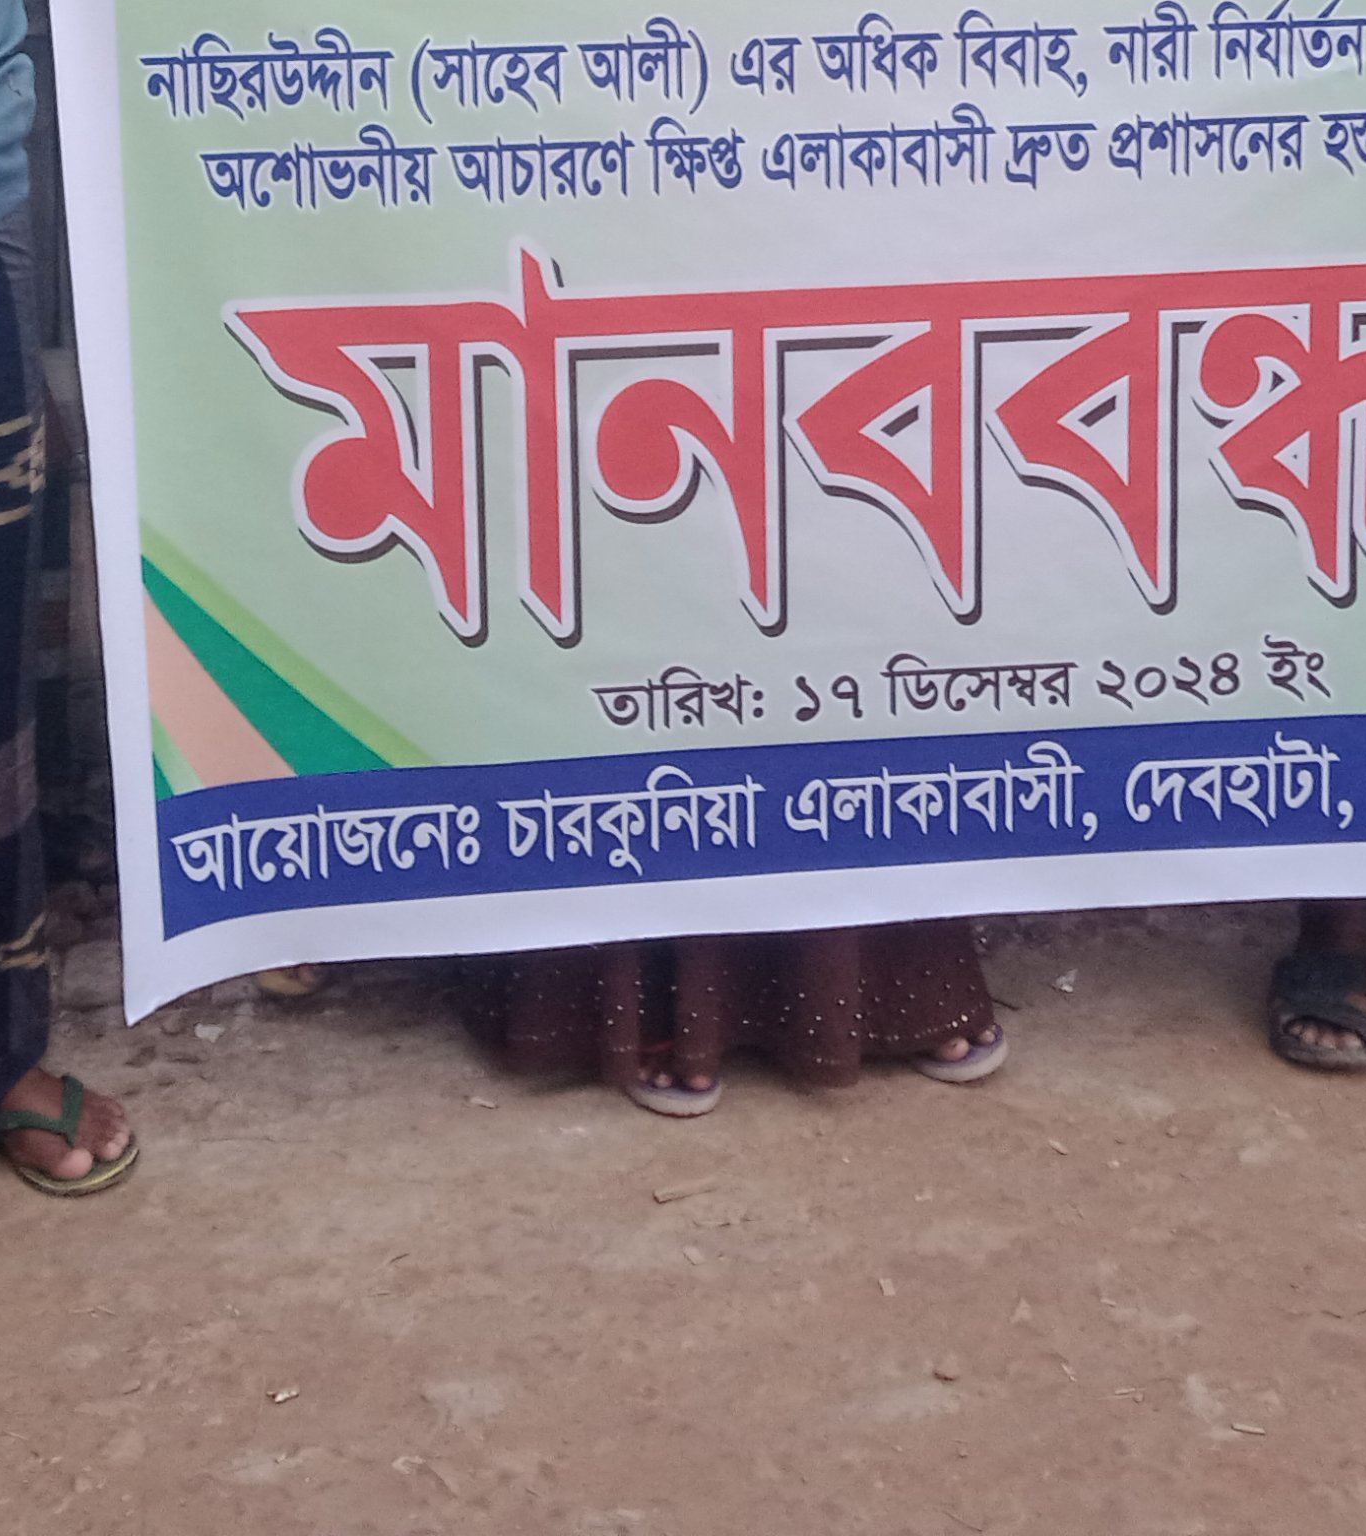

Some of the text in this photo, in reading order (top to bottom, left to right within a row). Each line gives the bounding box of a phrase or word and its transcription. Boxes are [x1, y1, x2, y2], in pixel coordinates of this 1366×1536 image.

[139, 27, 395, 121] নাছিরউদ্দীন
[411, 38, 568, 125] (সাহেব
[577, 16, 709, 116] আলী)
[731, 37, 802, 96] এর
[812, 12, 943, 94] অধিক
[953, 8, 1088, 99] বিবাহ,
[1102, 0, 1198, 85] নারী
[199, 124, 438, 211] অশোভনীয়
[446, 131, 636, 203] আচারণে
[644, 116, 746, 196] ক্ষিপ্ত
[761, 102, 996, 191] এলাকাবাসী
[1004, 122, 1098, 190] দ্রুত
[1108, 111, 1311, 180] প্রশাসনের
[795, 674, 864, 723] ১৭
[879, 653, 1079, 717] ডিসেম্বর
[1096, 652, 1241, 712] ২০২৪
[1261, 634, 1332, 702] ইং
[497, 764, 766, 876] চারকুনিয়া
[784, 740, 1099, 842] এলাকাবাসী,
[1125, 730, 1355, 831] দেবহাটা,
